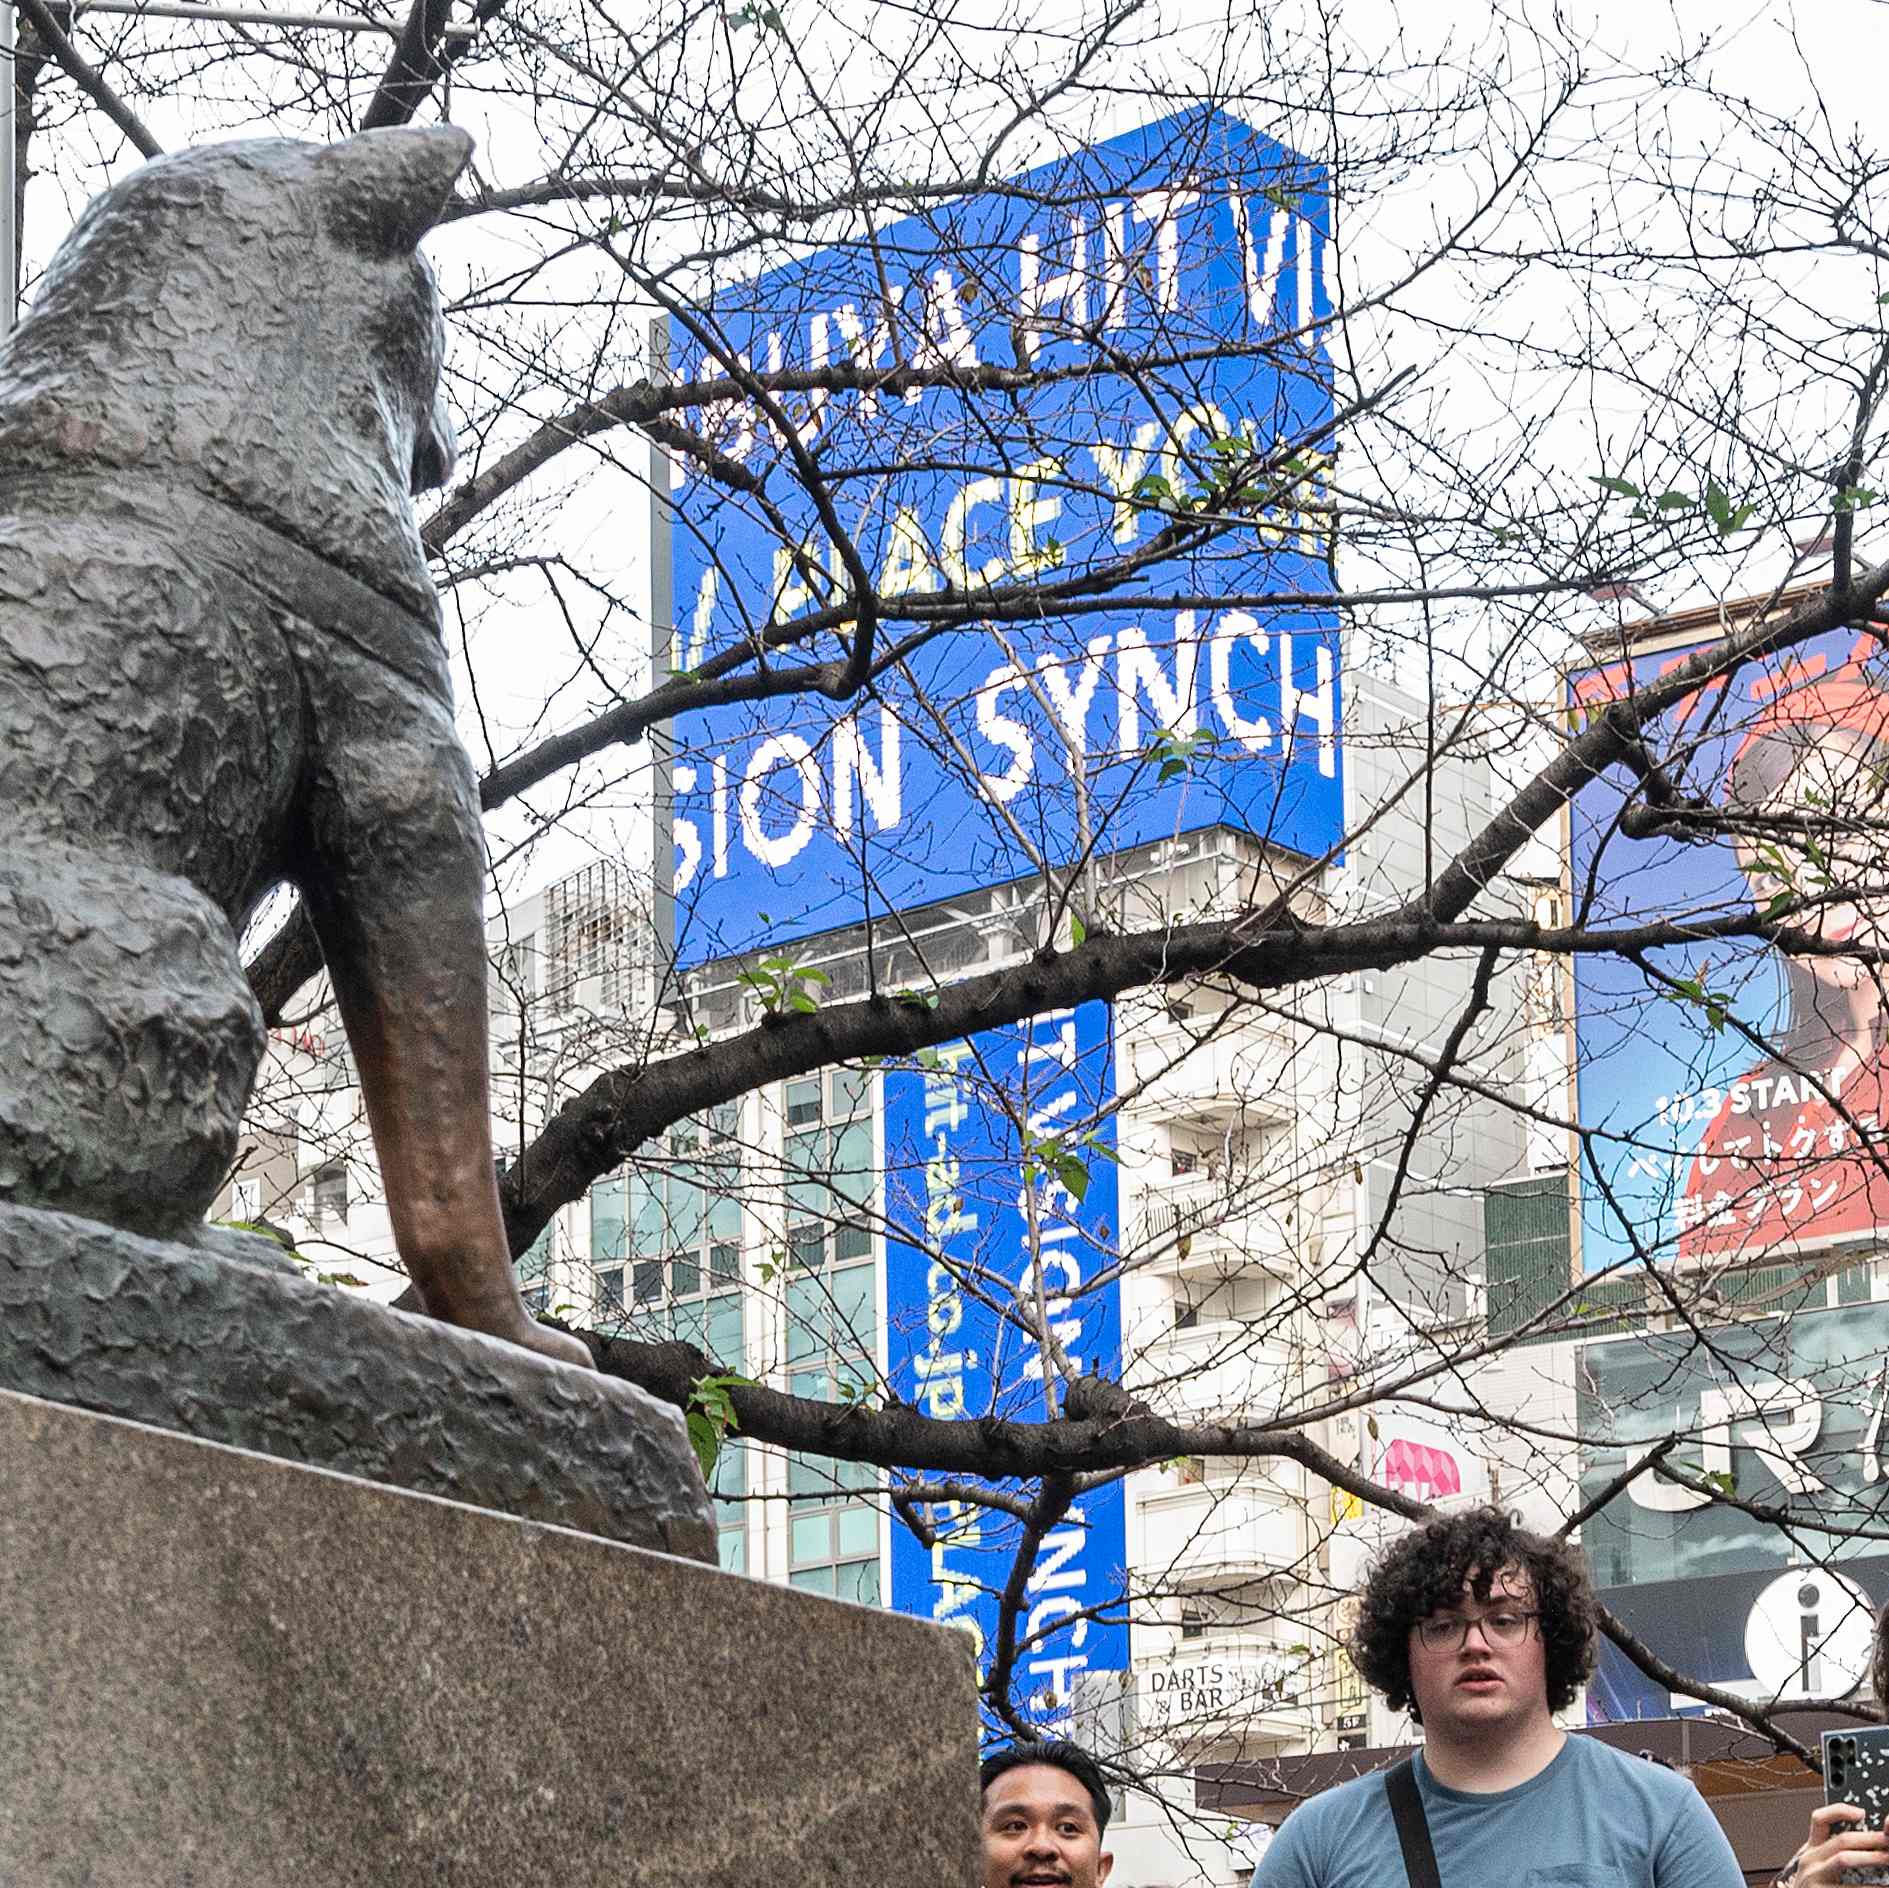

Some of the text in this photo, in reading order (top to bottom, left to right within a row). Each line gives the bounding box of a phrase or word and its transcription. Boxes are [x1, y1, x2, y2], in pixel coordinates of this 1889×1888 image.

[1020, 175, 1200, 362] HIT
[976, 608, 1335, 805] SYNCH
[1729, 1066, 1846, 1114] START
[1626, 1376, 1826, 1512] JR
[1151, 1664, 1223, 1692] DARTS
[1180, 1688, 1223, 1711] BAR
